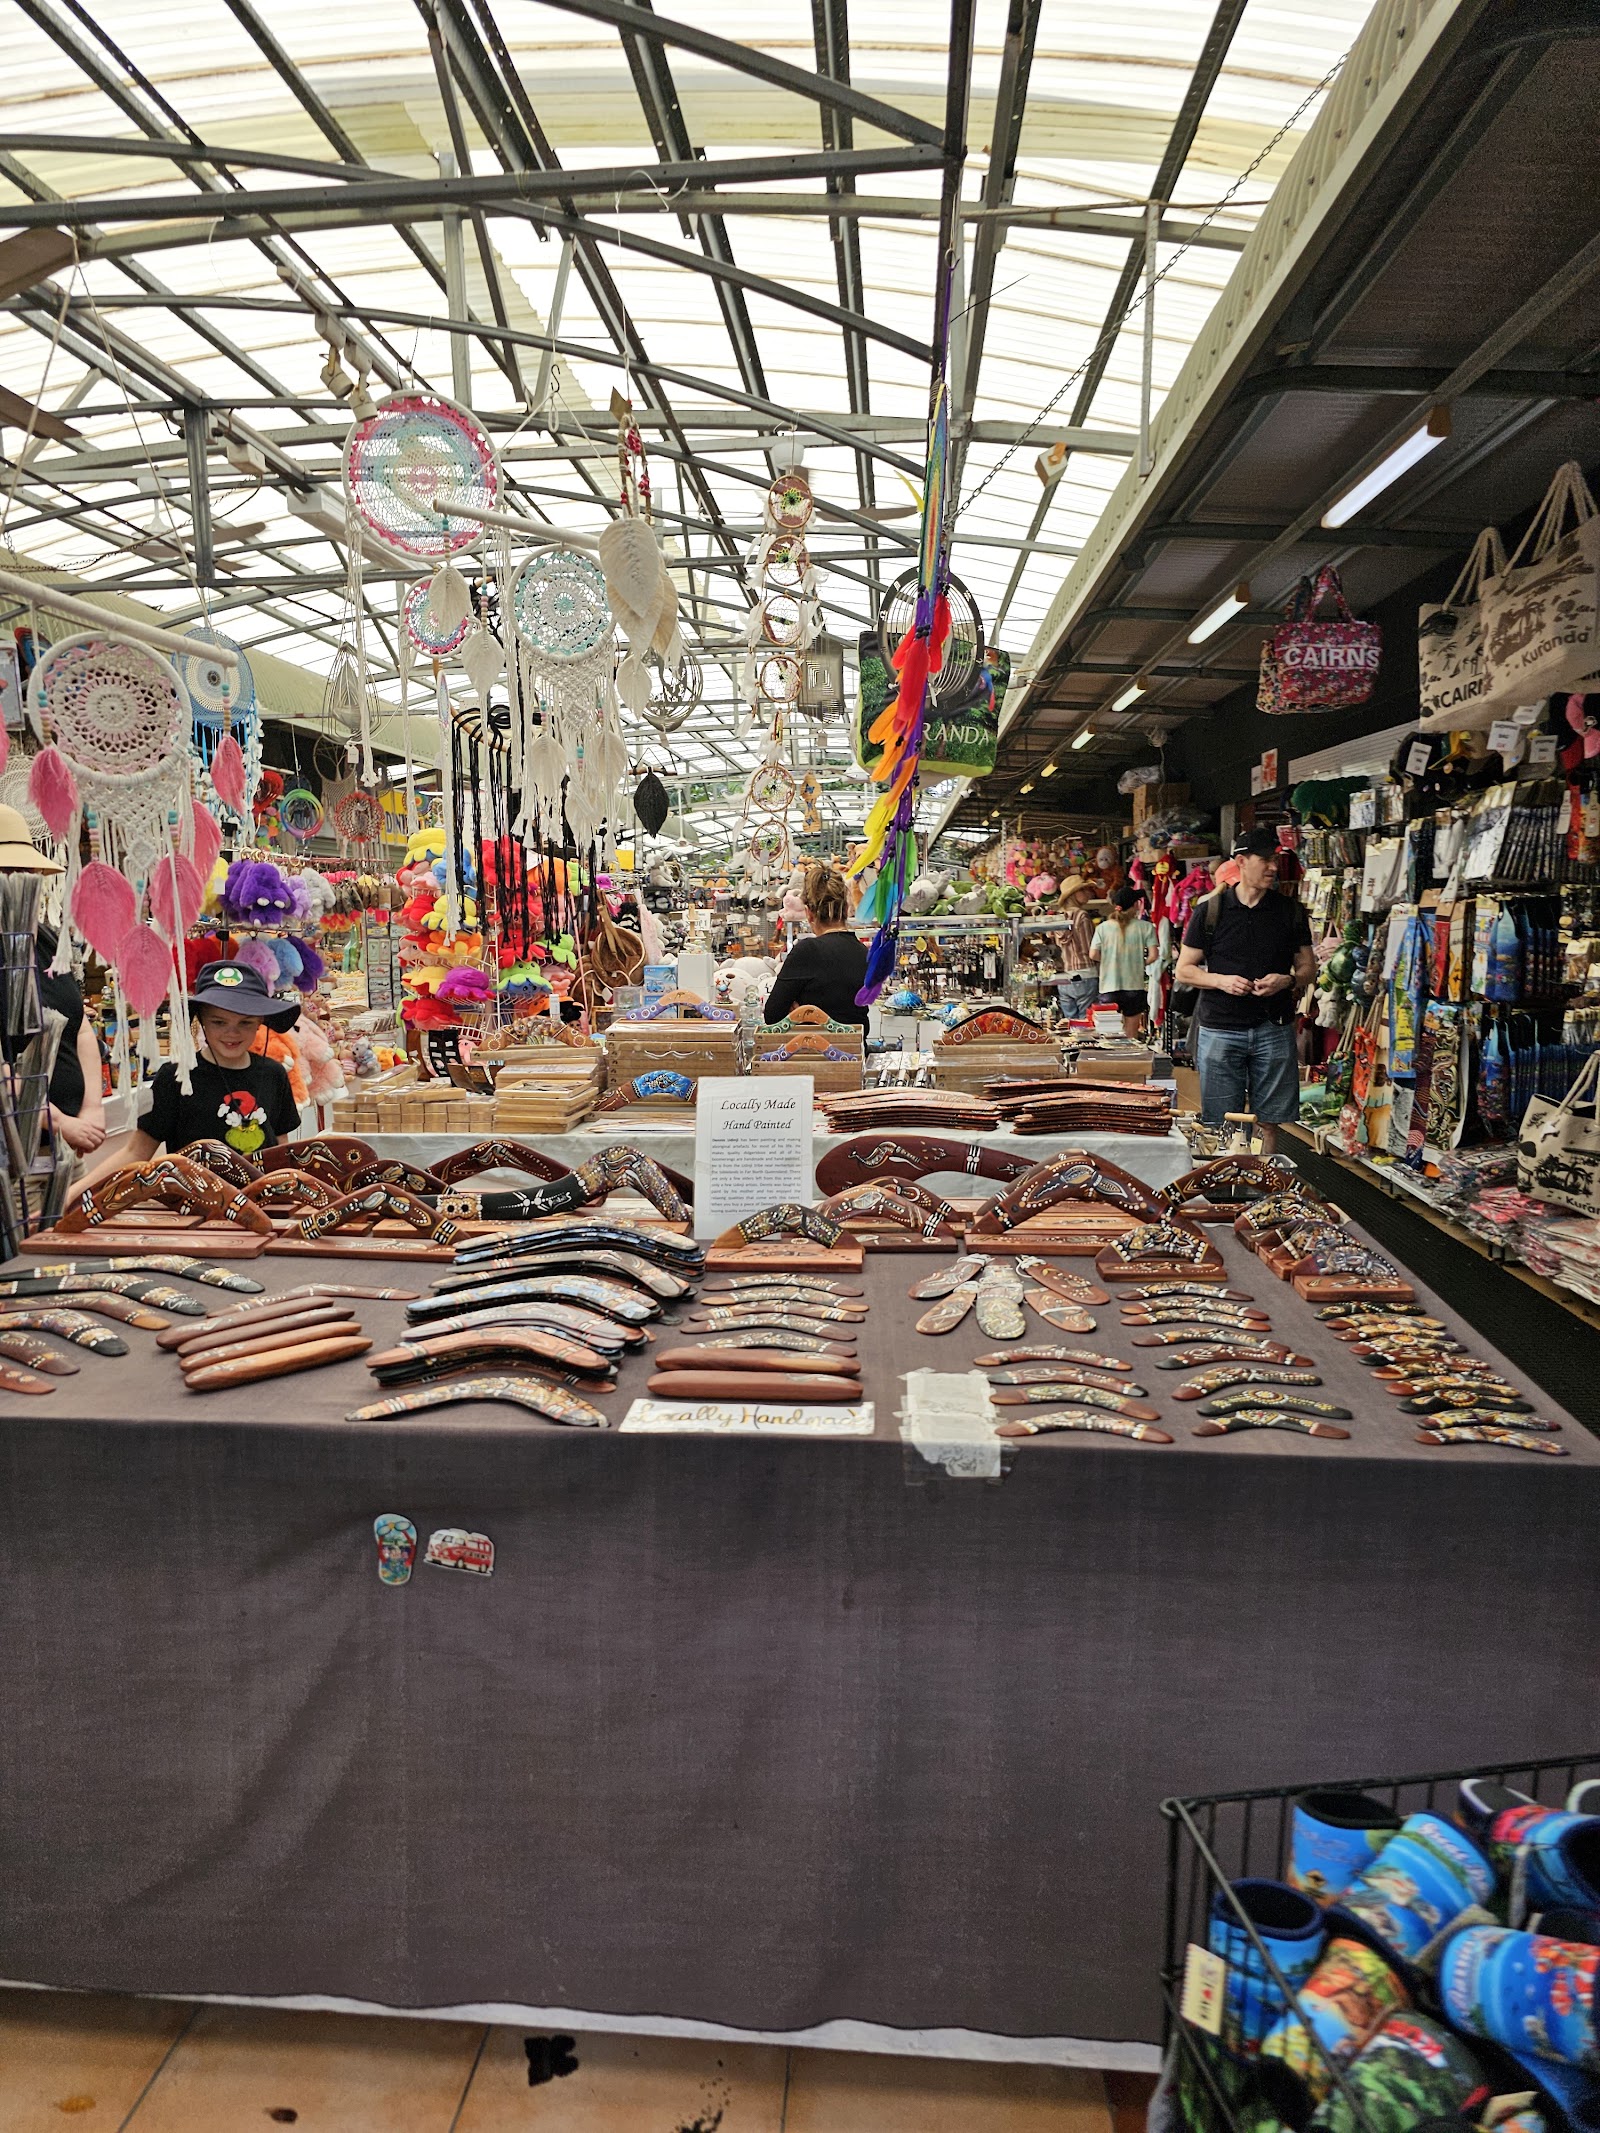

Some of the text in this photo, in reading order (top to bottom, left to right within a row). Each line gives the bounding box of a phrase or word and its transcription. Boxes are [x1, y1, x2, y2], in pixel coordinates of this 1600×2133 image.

[1284, 646, 1380, 667] CAIRNS
[922, 722, 990, 746] RANDA
[720, 1098, 796, 1113] Locally Made
[722, 1119, 794, 1130] Hand Painted
[629, 1403, 734, 1427] Locally
